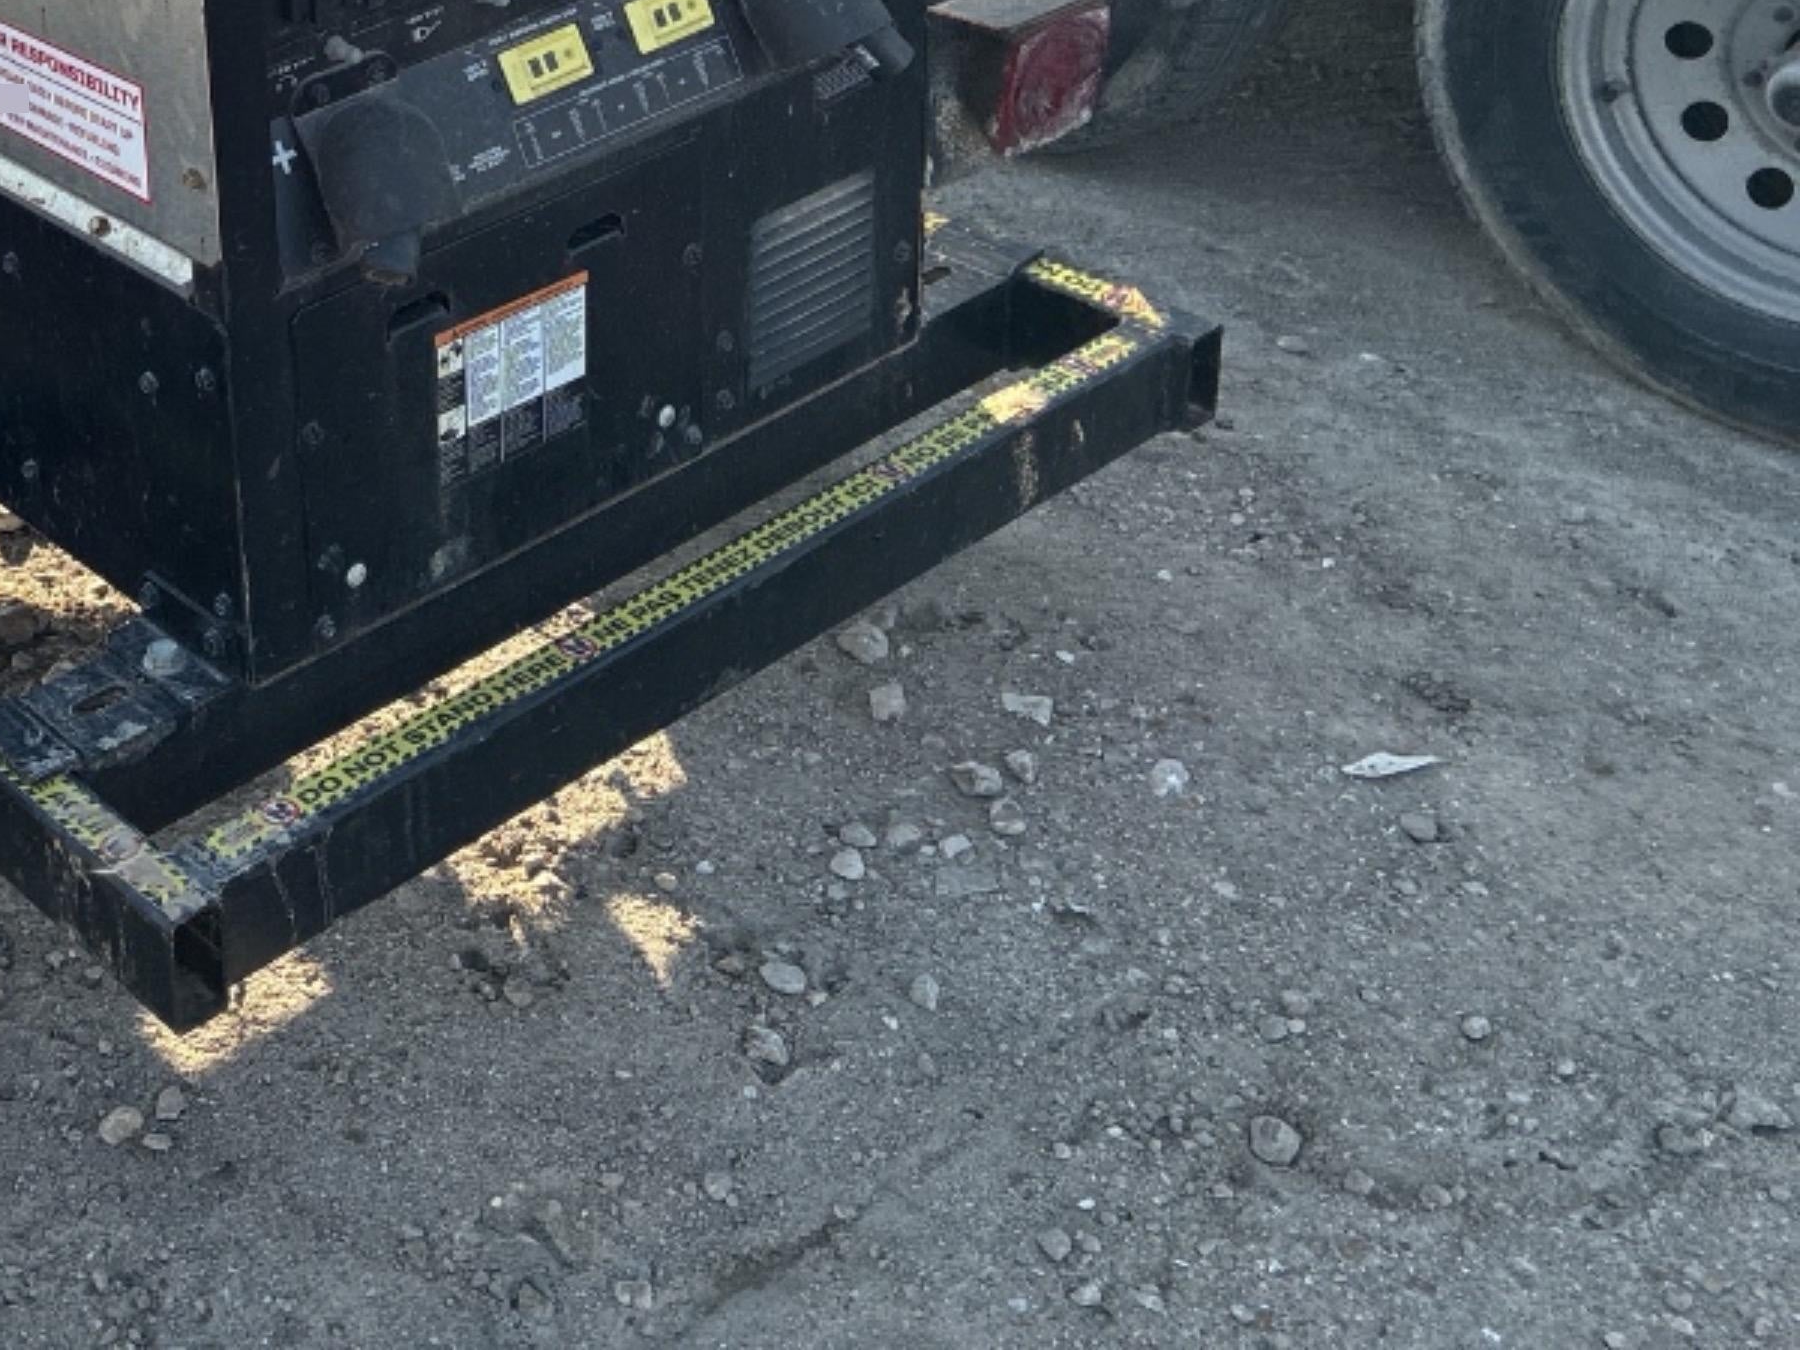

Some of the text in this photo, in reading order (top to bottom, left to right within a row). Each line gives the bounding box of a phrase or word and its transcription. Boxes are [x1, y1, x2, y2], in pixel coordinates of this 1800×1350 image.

[10, 38, 140, 111] RESPONSIBILITY
[301, 653, 567, 806] DO NOT STAND HERE
